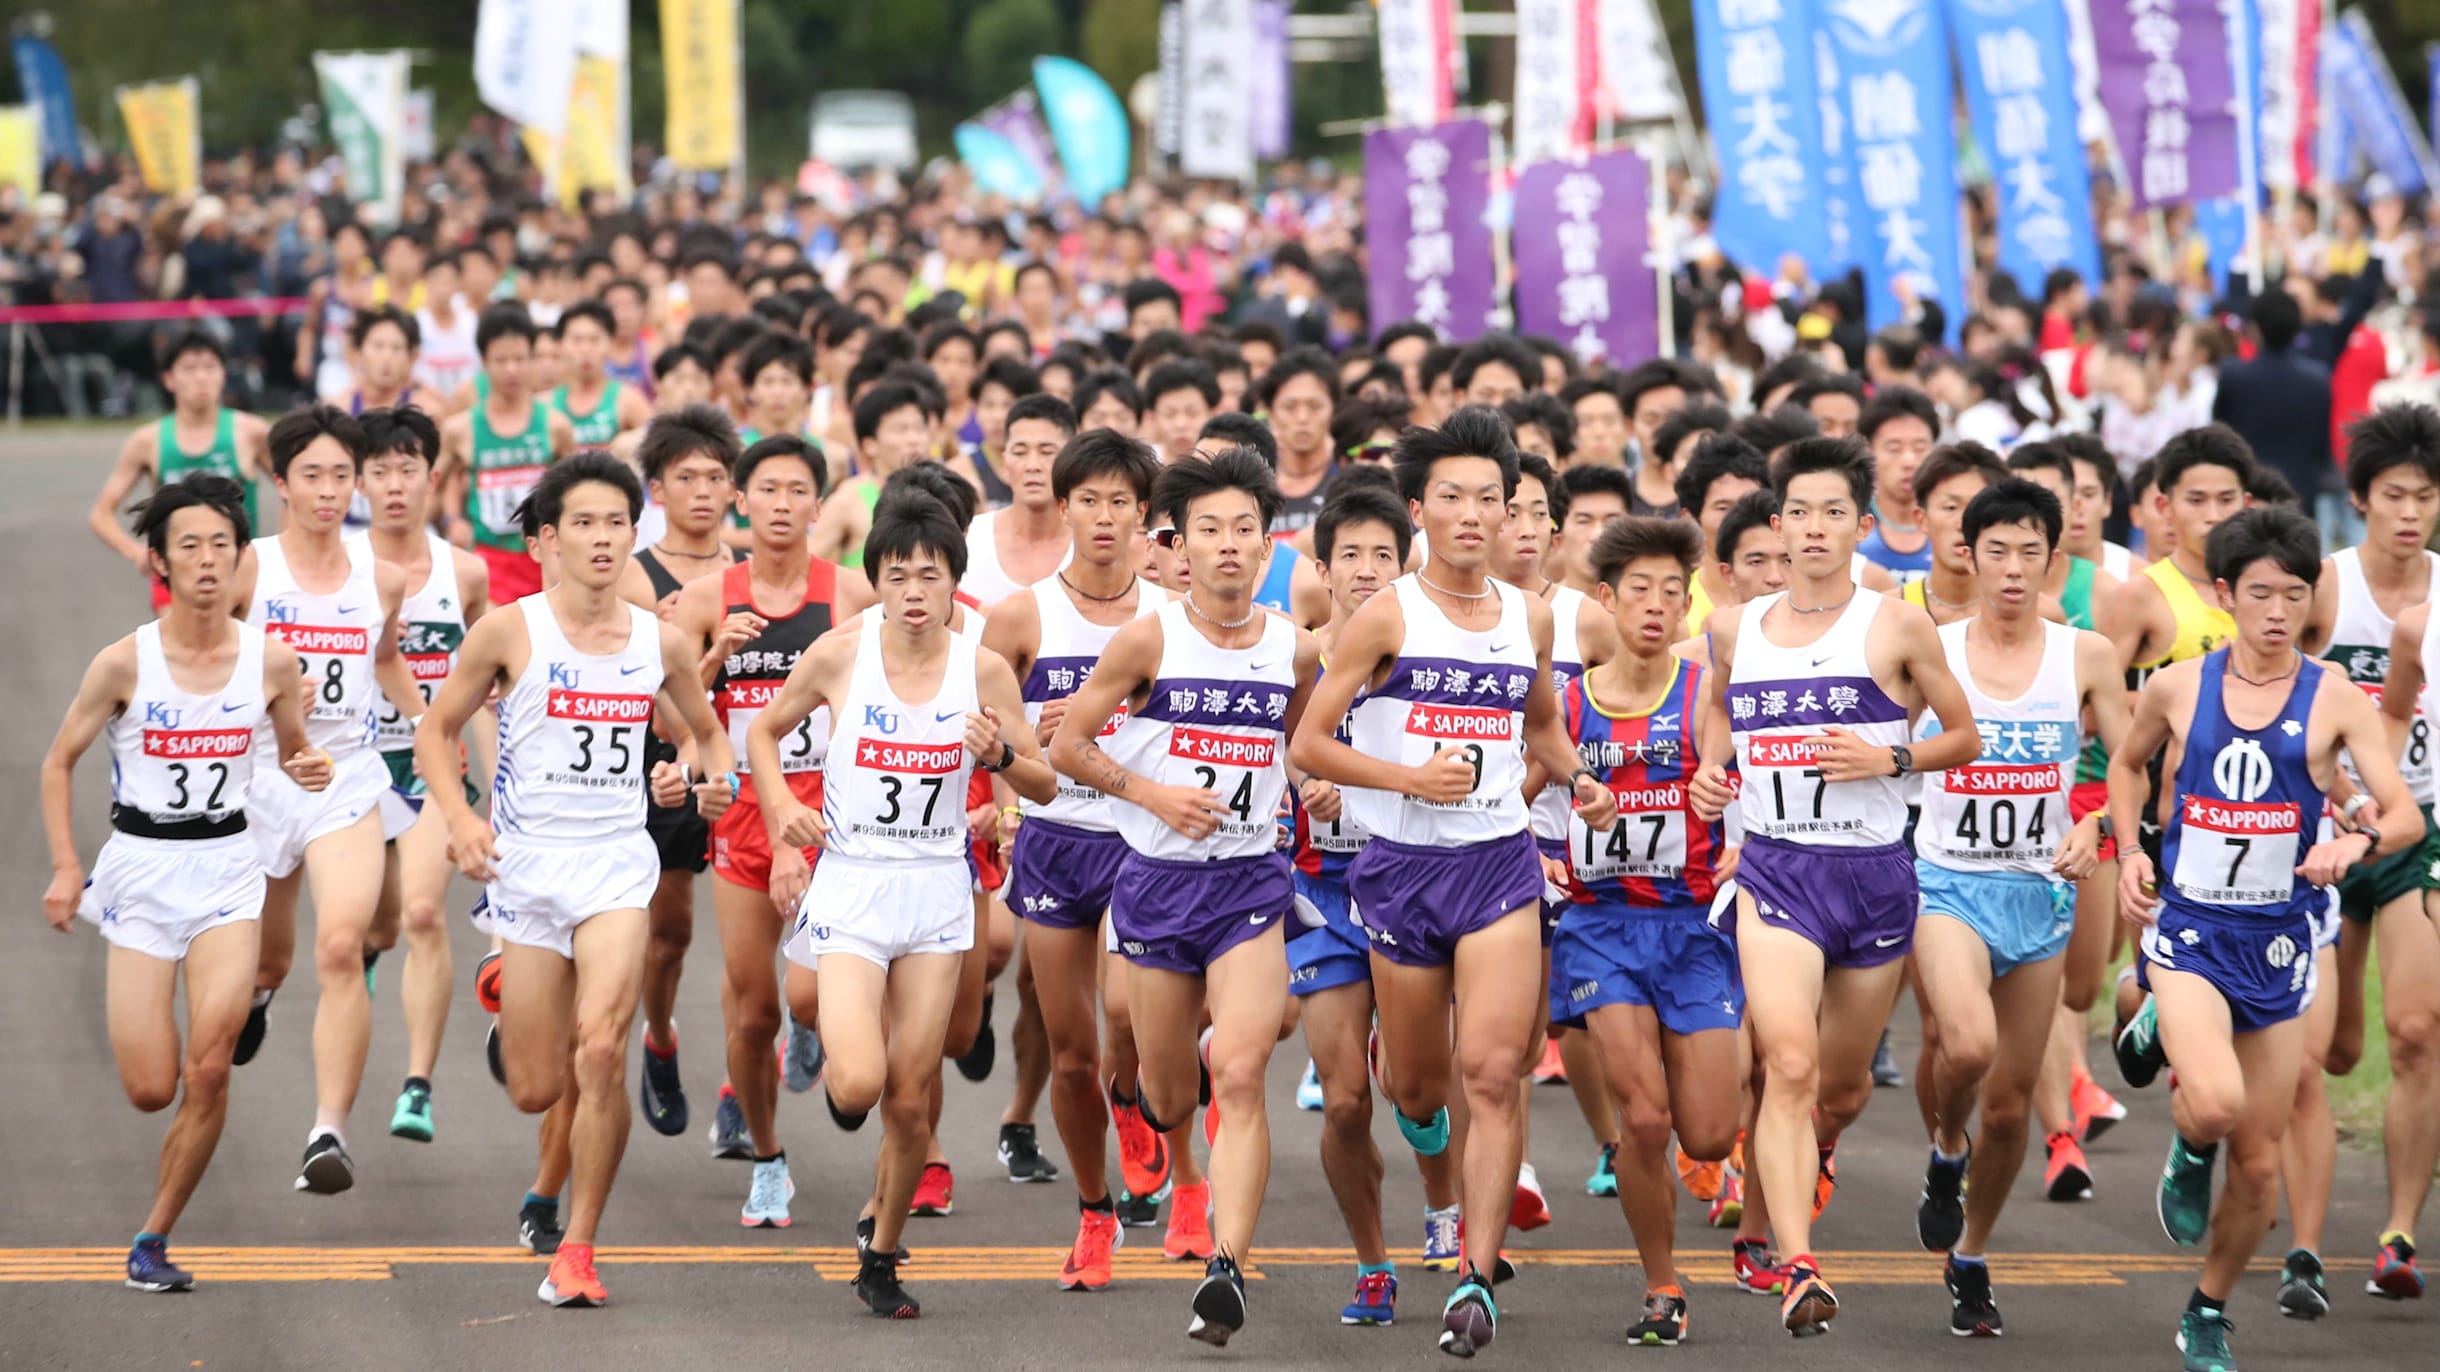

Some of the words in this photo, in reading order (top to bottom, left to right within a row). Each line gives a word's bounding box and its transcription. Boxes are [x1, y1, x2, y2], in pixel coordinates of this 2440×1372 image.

[265, 599, 299, 624] KU
[289, 630, 365, 651] SAPPORO
[549, 662, 580, 690] KU
[1411, 667, 1530, 700] 駒澤大學
[146, 702, 182, 729] KU
[574, 697, 650, 719] SAPPORO
[1731, 685, 1860, 720] 駒澤大學
[864, 704, 898, 735] KU
[1434, 714, 1509, 735] SAPPORO
[166, 733, 248, 754] SAPPORO
[569, 725, 631, 775] 35
[882, 747, 960, 769] SAPPORO
[166, 762, 229, 810] 32
[1195, 765, 1252, 822] 24
[1773, 769, 1828, 820] 17
[1970, 770, 2058, 790] SAPPORO
[875, 776, 943, 826] 37
[1957, 799, 2045, 848] 404
[2207, 806, 2297, 829] SAPPORO
[1585, 815, 1666, 865] 147
[2224, 838, 2251, 887] 7
